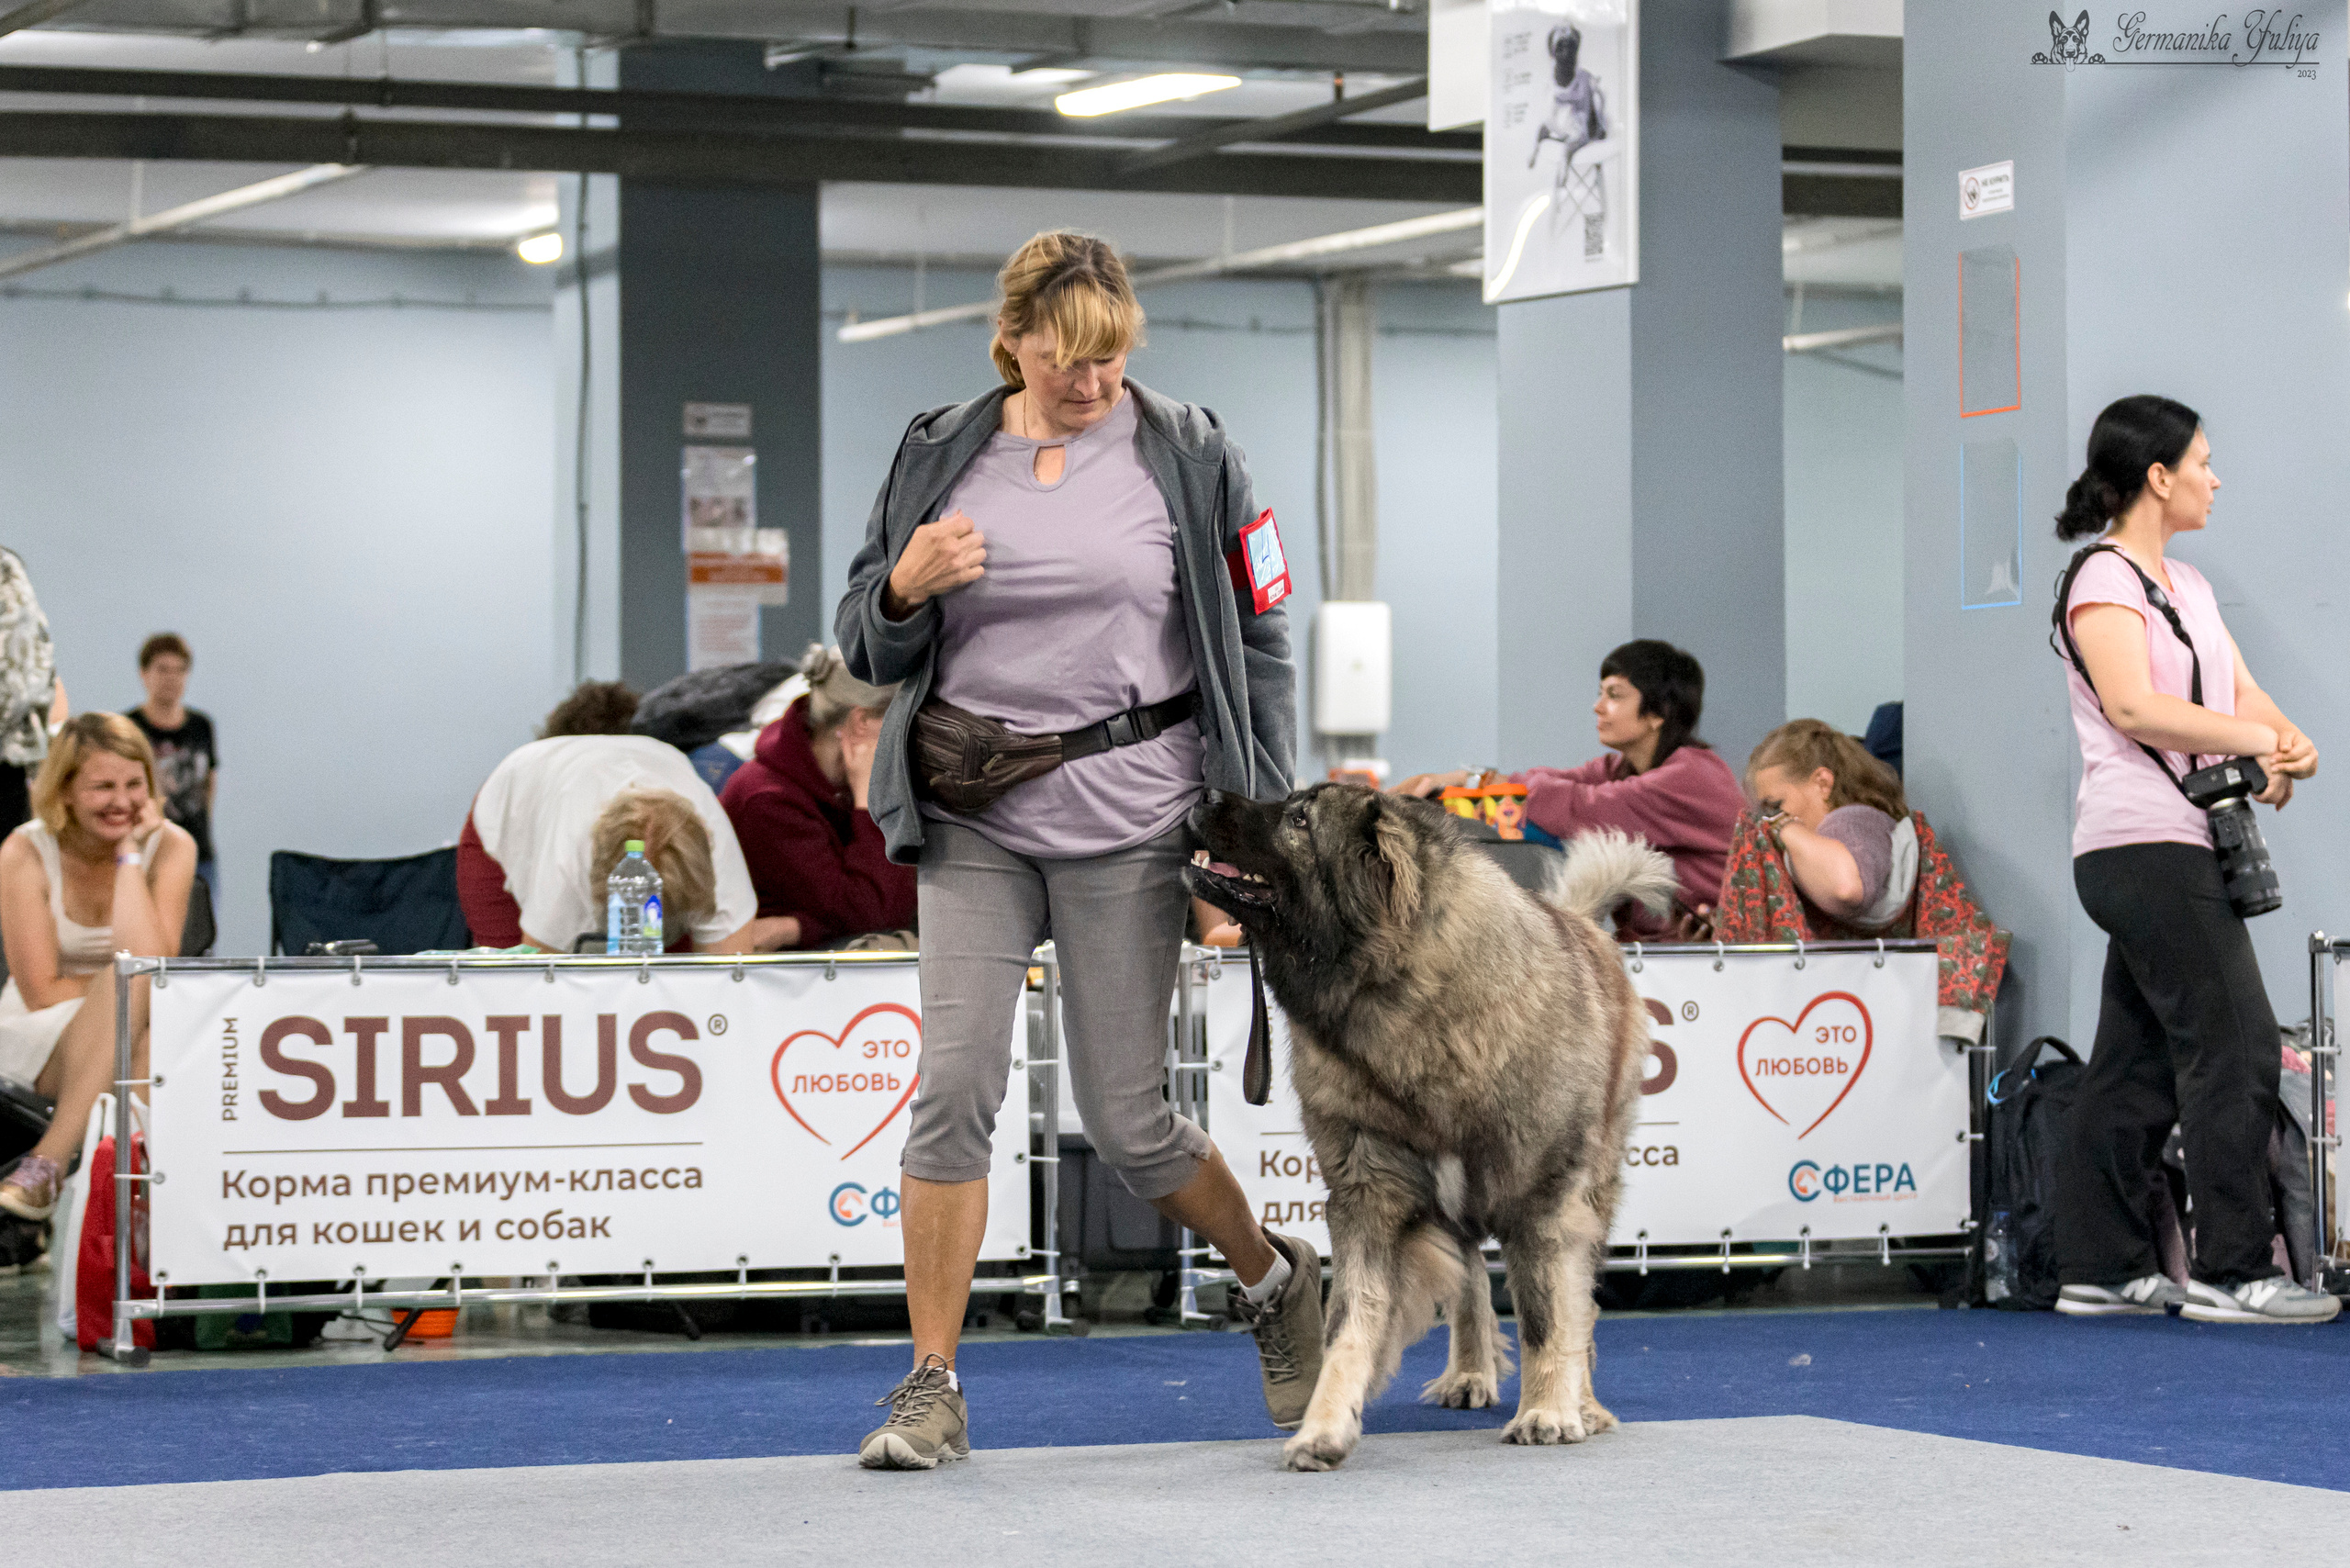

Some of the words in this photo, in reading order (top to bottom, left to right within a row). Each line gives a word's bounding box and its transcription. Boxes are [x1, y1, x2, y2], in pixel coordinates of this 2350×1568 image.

[862, 1039, 910, 1059] ЭТО
[1815, 1025, 1857, 1045] ЭТО
[221, 1017, 239, 1122] PREMIUM
[1755, 1057, 1849, 1077] ЛЮБОВЬ
[792, 1072, 901, 1094] ЛЮБОВЬ
[1259, 1149, 1322, 1184] Кор
[1788, 1159, 1917, 1203] СФЕРА
[222, 1170, 351, 1205] Корма
[366, 1166, 703, 1204] премиум-класса
[1260, 1200, 1326, 1227] для
[223, 1222, 297, 1252] для
[313, 1219, 445, 1245] кошек
[459, 1218, 481, 1241] и
[495, 1207, 612, 1241] собак
